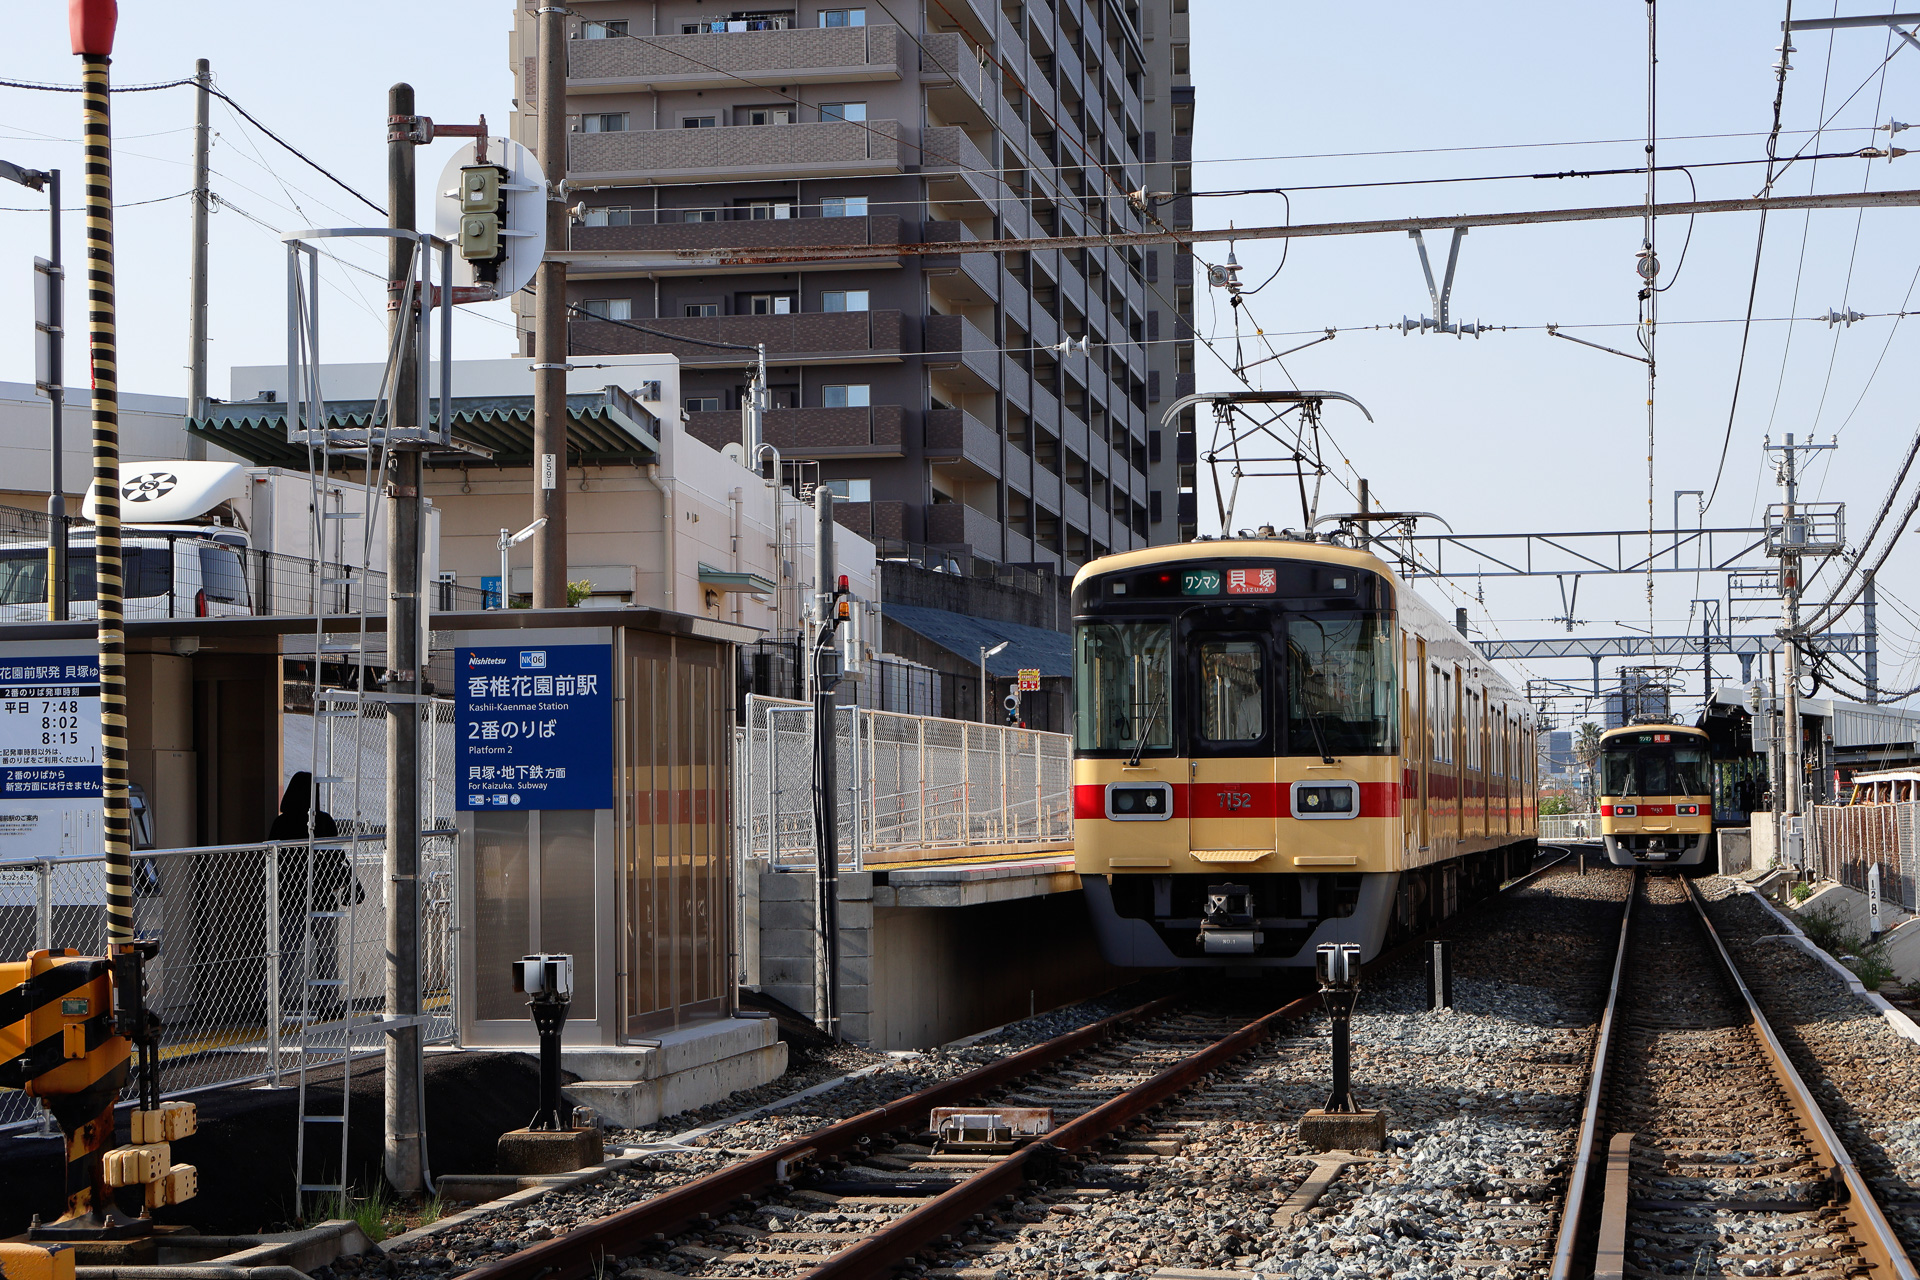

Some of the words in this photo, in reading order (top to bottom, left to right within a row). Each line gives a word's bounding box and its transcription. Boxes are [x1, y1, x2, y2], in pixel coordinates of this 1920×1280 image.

[1185, 575, 1220, 590] ワンマン
[1230, 569, 1276, 588] 貝塚
[468, 657, 507, 665] Nishitetsu
[521, 656, 532, 664] NK
[532, 656, 544, 664] 06
[5, 687, 80, 697] 2番のりば発車時刻
[468, 674, 598, 698] 香椎花園前駅
[5, 701, 29, 714] 平日
[42, 701, 78, 713] 7:48
[468, 703, 537, 712] Kashii-Kaenmae
[538, 702, 569, 711] Station
[42, 716, 78, 729] 8:02
[468, 719, 557, 740] 2番のりば
[42, 732, 78, 744] 8:15
[468, 746, 506, 755] Platform
[507, 745, 513, 754] 2
[7, 770, 66, 780] 2番のりばから
[517, 782, 548, 791] Subway
[1217, 793, 1252, 808] 7152
[1870, 890, 1876, 899] 2
[1871, 903, 1878, 915] 8
